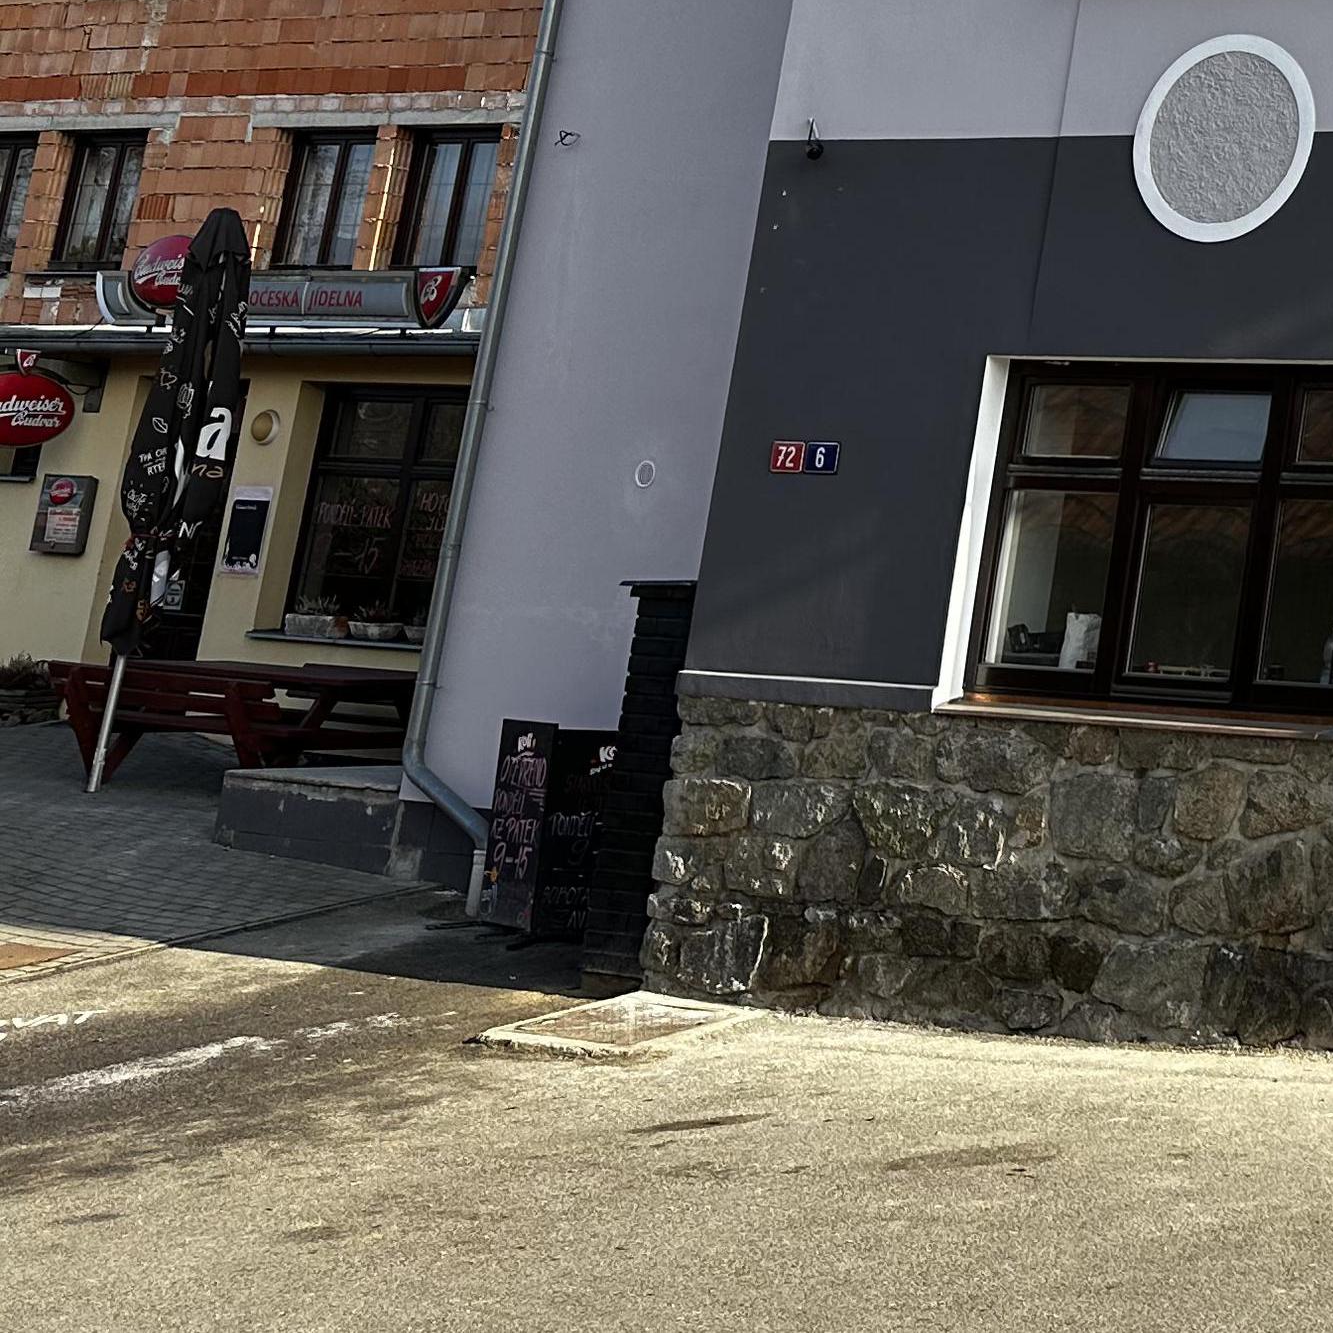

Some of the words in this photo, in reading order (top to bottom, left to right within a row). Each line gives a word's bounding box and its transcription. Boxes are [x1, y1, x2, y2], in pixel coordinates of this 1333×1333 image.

[307, 284, 363, 309] JÍDELNA
[776, 446, 796, 467] 72
[815, 447, 826, 468] 6
